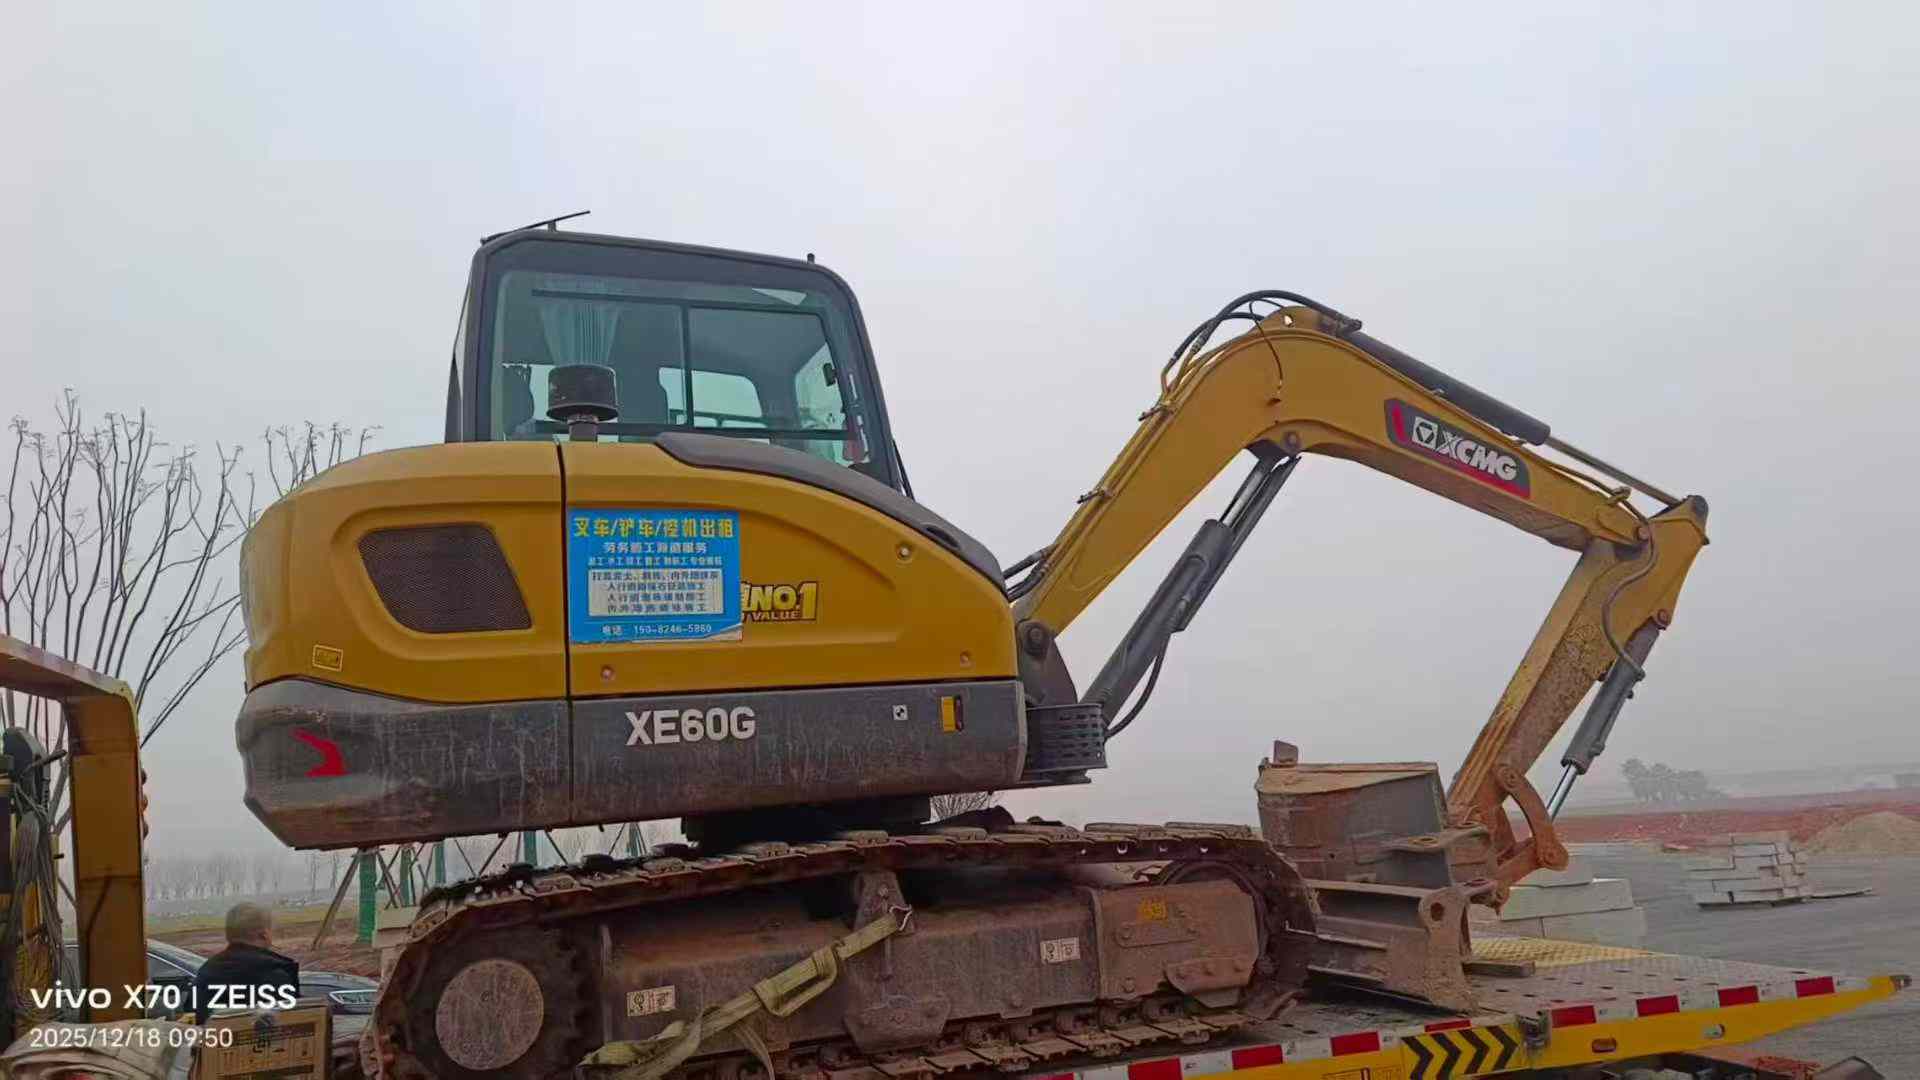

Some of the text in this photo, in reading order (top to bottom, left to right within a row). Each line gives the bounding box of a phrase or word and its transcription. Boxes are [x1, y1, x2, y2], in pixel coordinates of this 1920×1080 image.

[1436, 430, 1518, 481] XCMG
[752, 610, 801, 621] VALUE
[625, 705, 756, 747] XE60G
